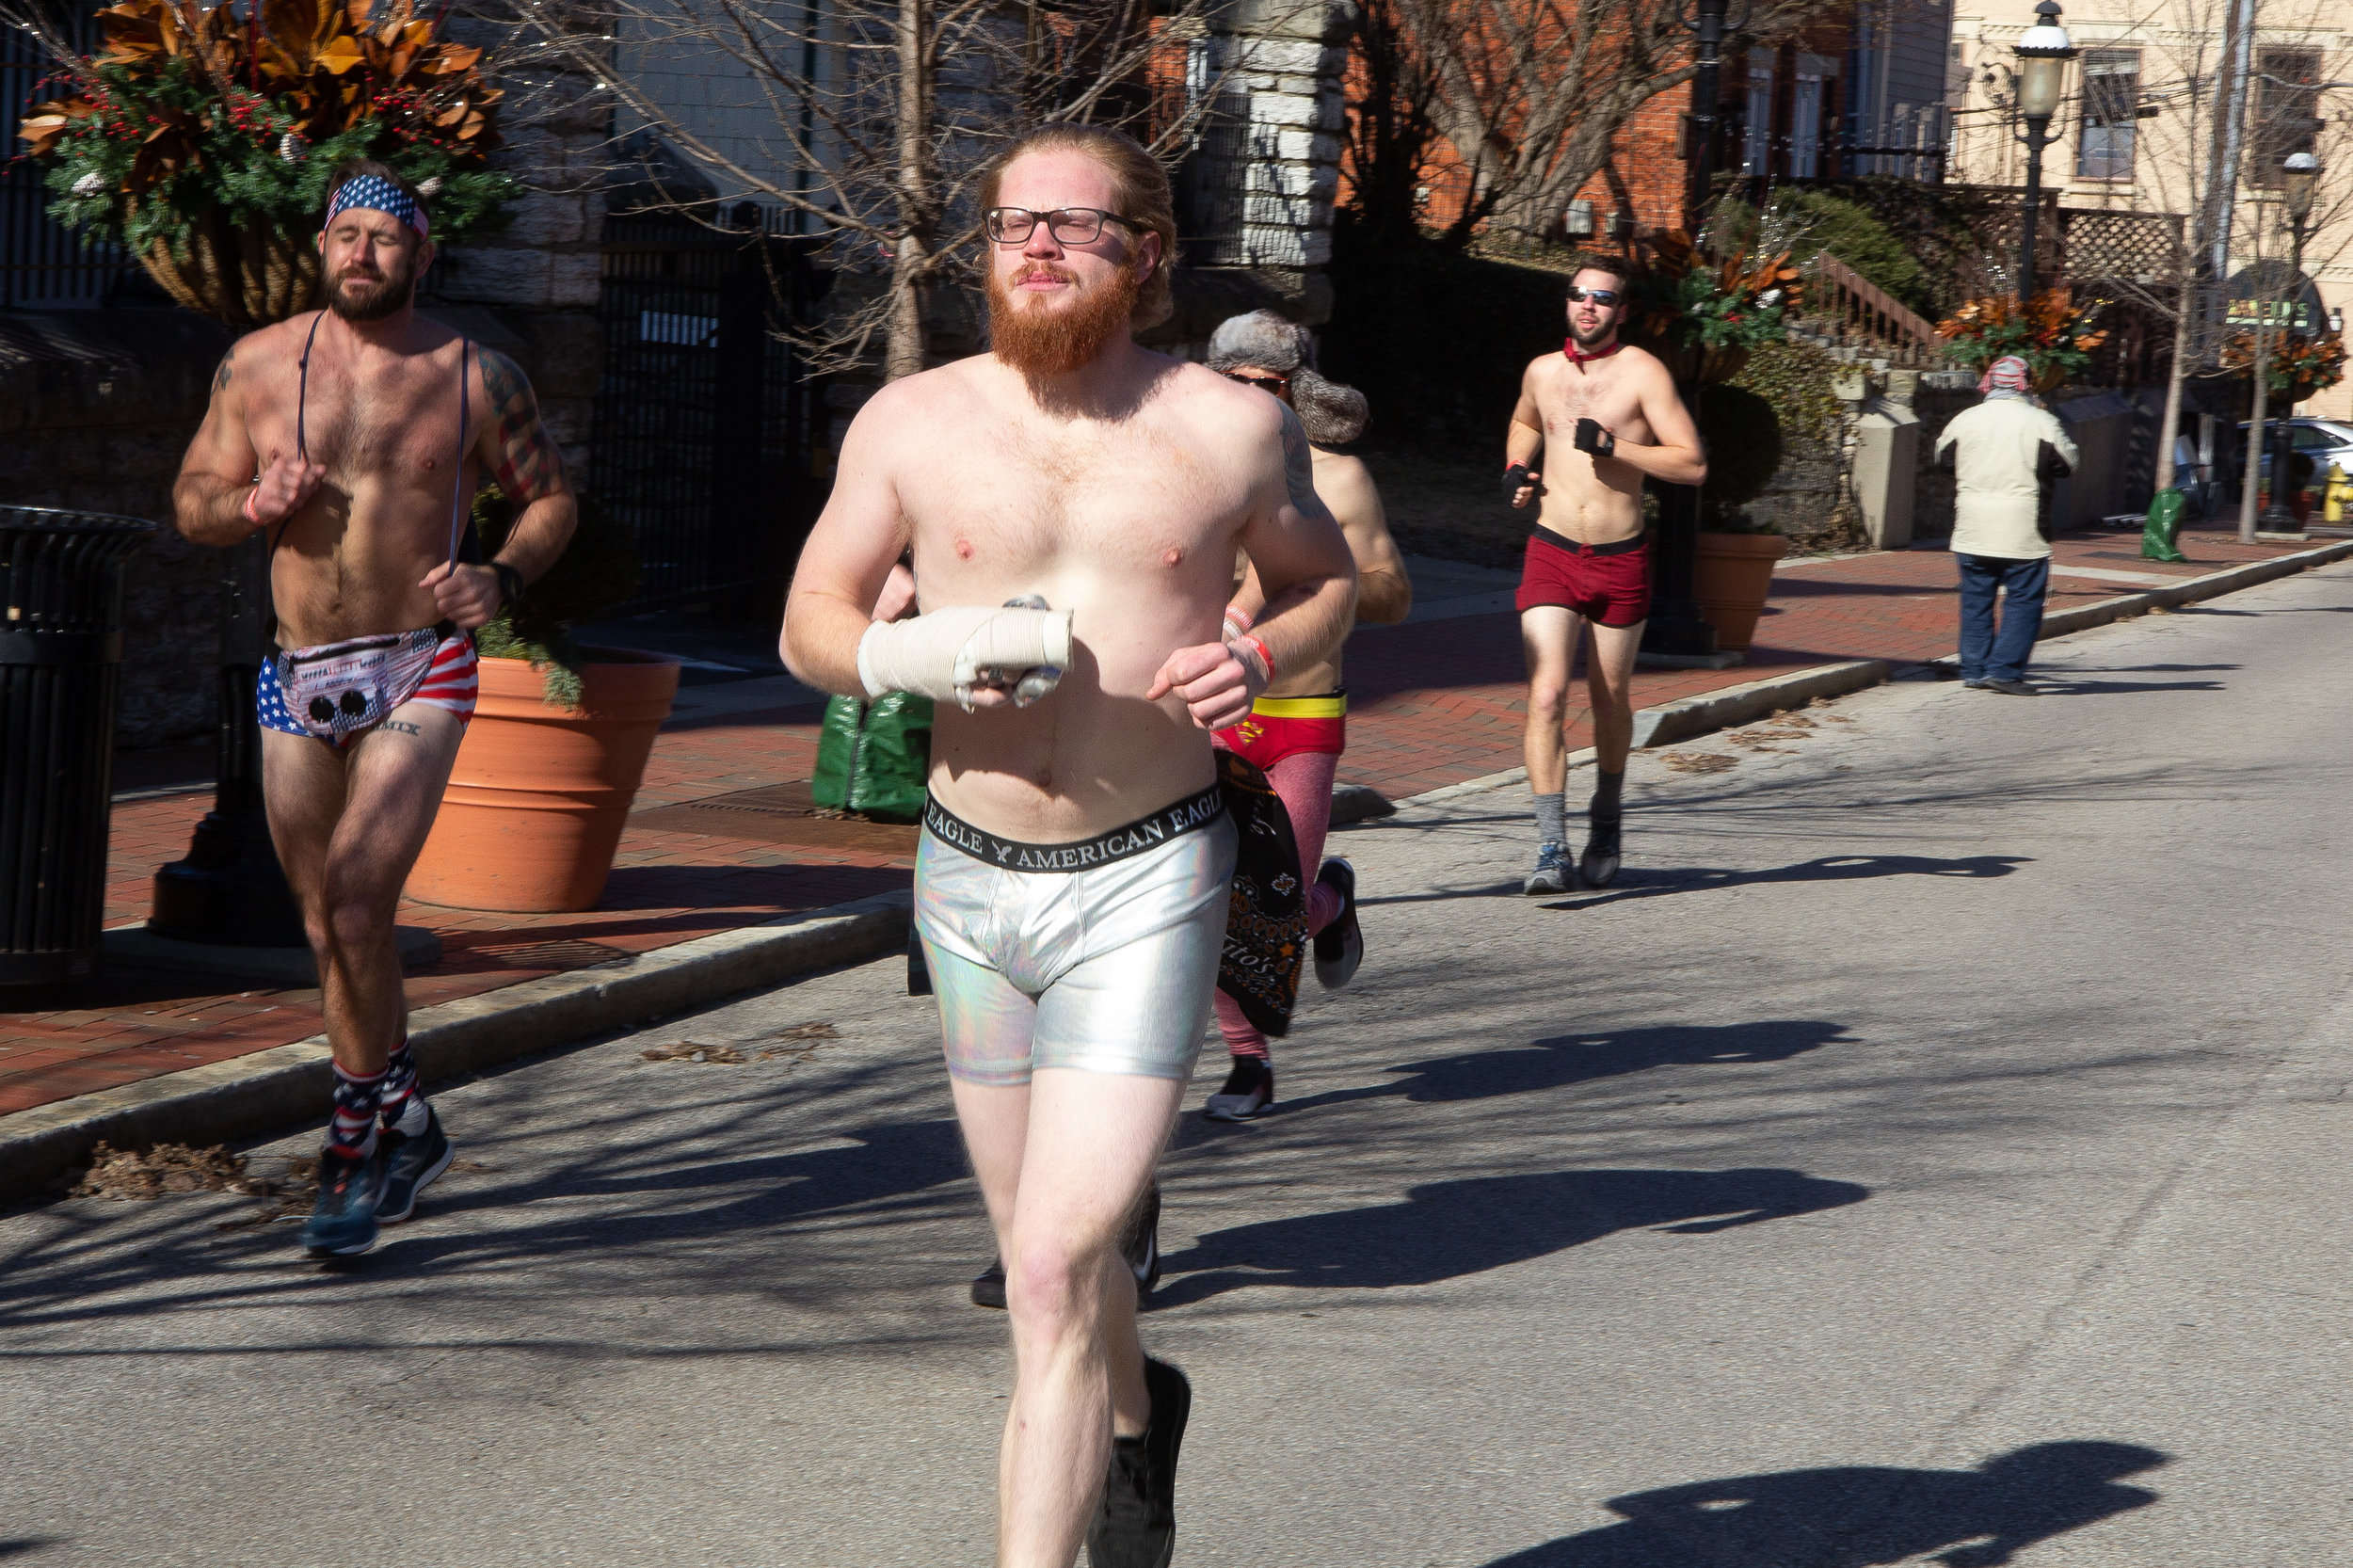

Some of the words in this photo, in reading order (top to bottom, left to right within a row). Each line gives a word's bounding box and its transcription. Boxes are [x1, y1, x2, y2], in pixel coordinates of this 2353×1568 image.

[927, 802, 983, 854] EAGLE
[1016, 819, 1164, 869] AMERICAN
[1223, 935, 1274, 974] ito's
